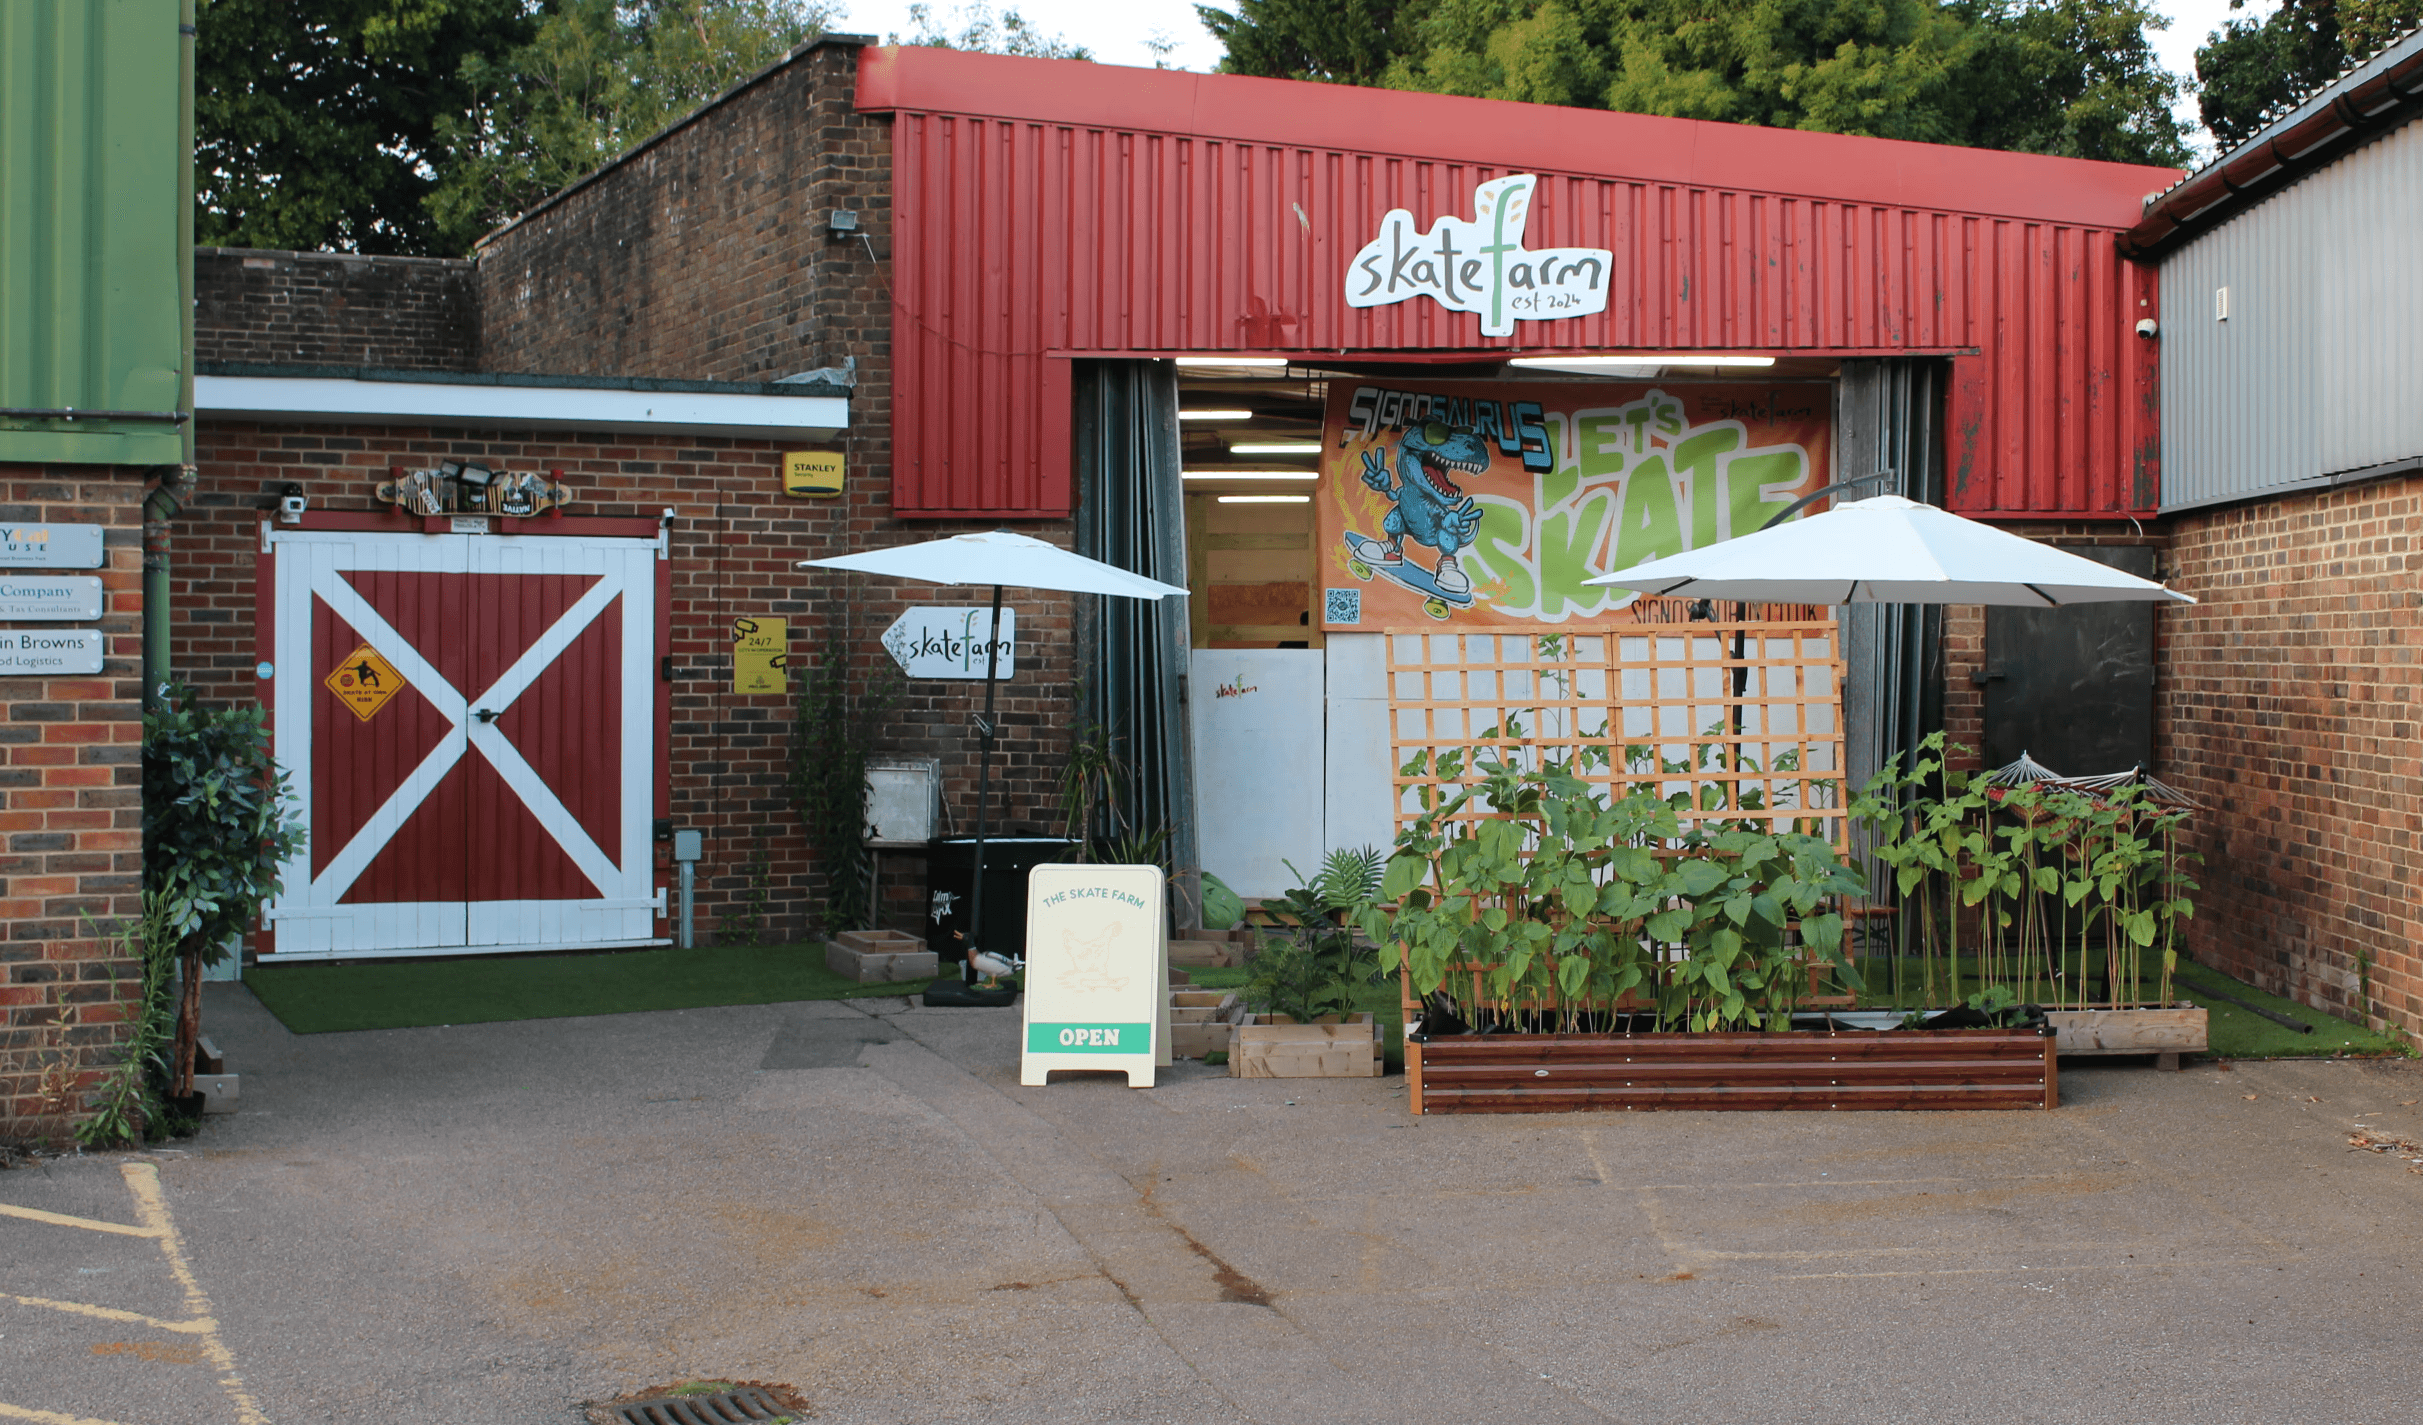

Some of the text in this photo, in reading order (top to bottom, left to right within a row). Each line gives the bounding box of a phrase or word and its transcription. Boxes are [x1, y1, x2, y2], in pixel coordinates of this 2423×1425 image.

[1511, 291, 1582, 313] est 2024
[794, 463, 837, 473] STANLEY
[502, 502, 531, 514] NATIVE
[0, 584, 74, 600] Company
[28, 605, 82, 613] Consultants
[21, 635, 85, 649] Browns
[748, 637, 772, 647] 24/7
[16, 656, 64, 668] Logistics
[1042, 887, 1146, 910] THE SKATE FARM
[1058, 1028, 1121, 1047] OPEN
